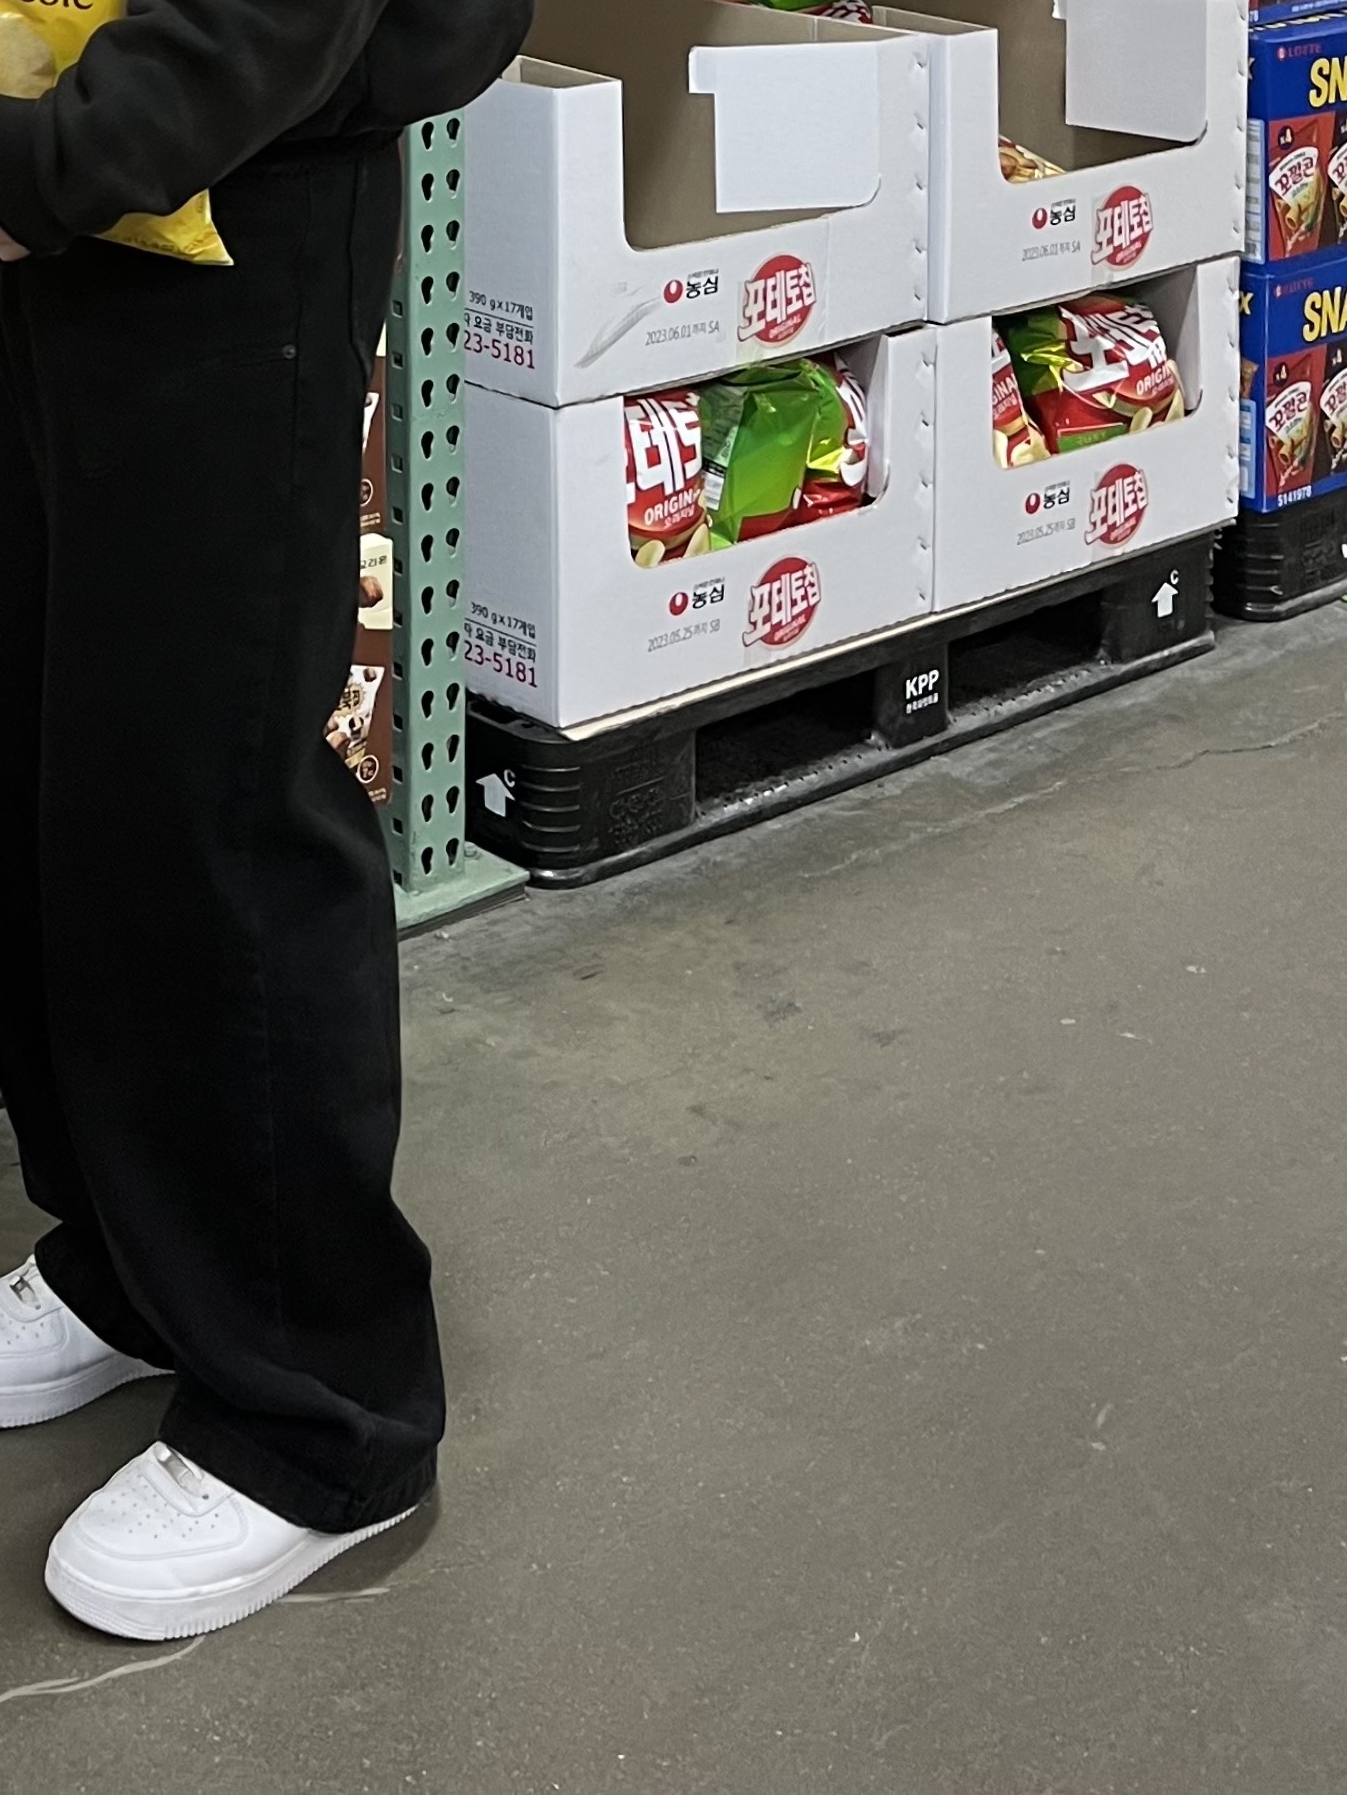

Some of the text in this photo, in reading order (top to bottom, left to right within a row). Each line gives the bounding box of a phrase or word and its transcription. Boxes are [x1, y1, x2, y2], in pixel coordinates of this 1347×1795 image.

[1049, 202, 1077, 226] 농심
[1091, 193, 1154, 266] 포테토칩
[685, 275, 720, 300] 농심
[738, 261, 818, 342] 포테토칩
[474, 314, 493, 332] 요금
[463, 334, 536, 369] 23-5181
[691, 585, 725, 610] 농심
[742, 562, 822, 647] 포테토칩
[464, 641, 537, 687] 23-5181
[906, 669, 940, 700] KPP
